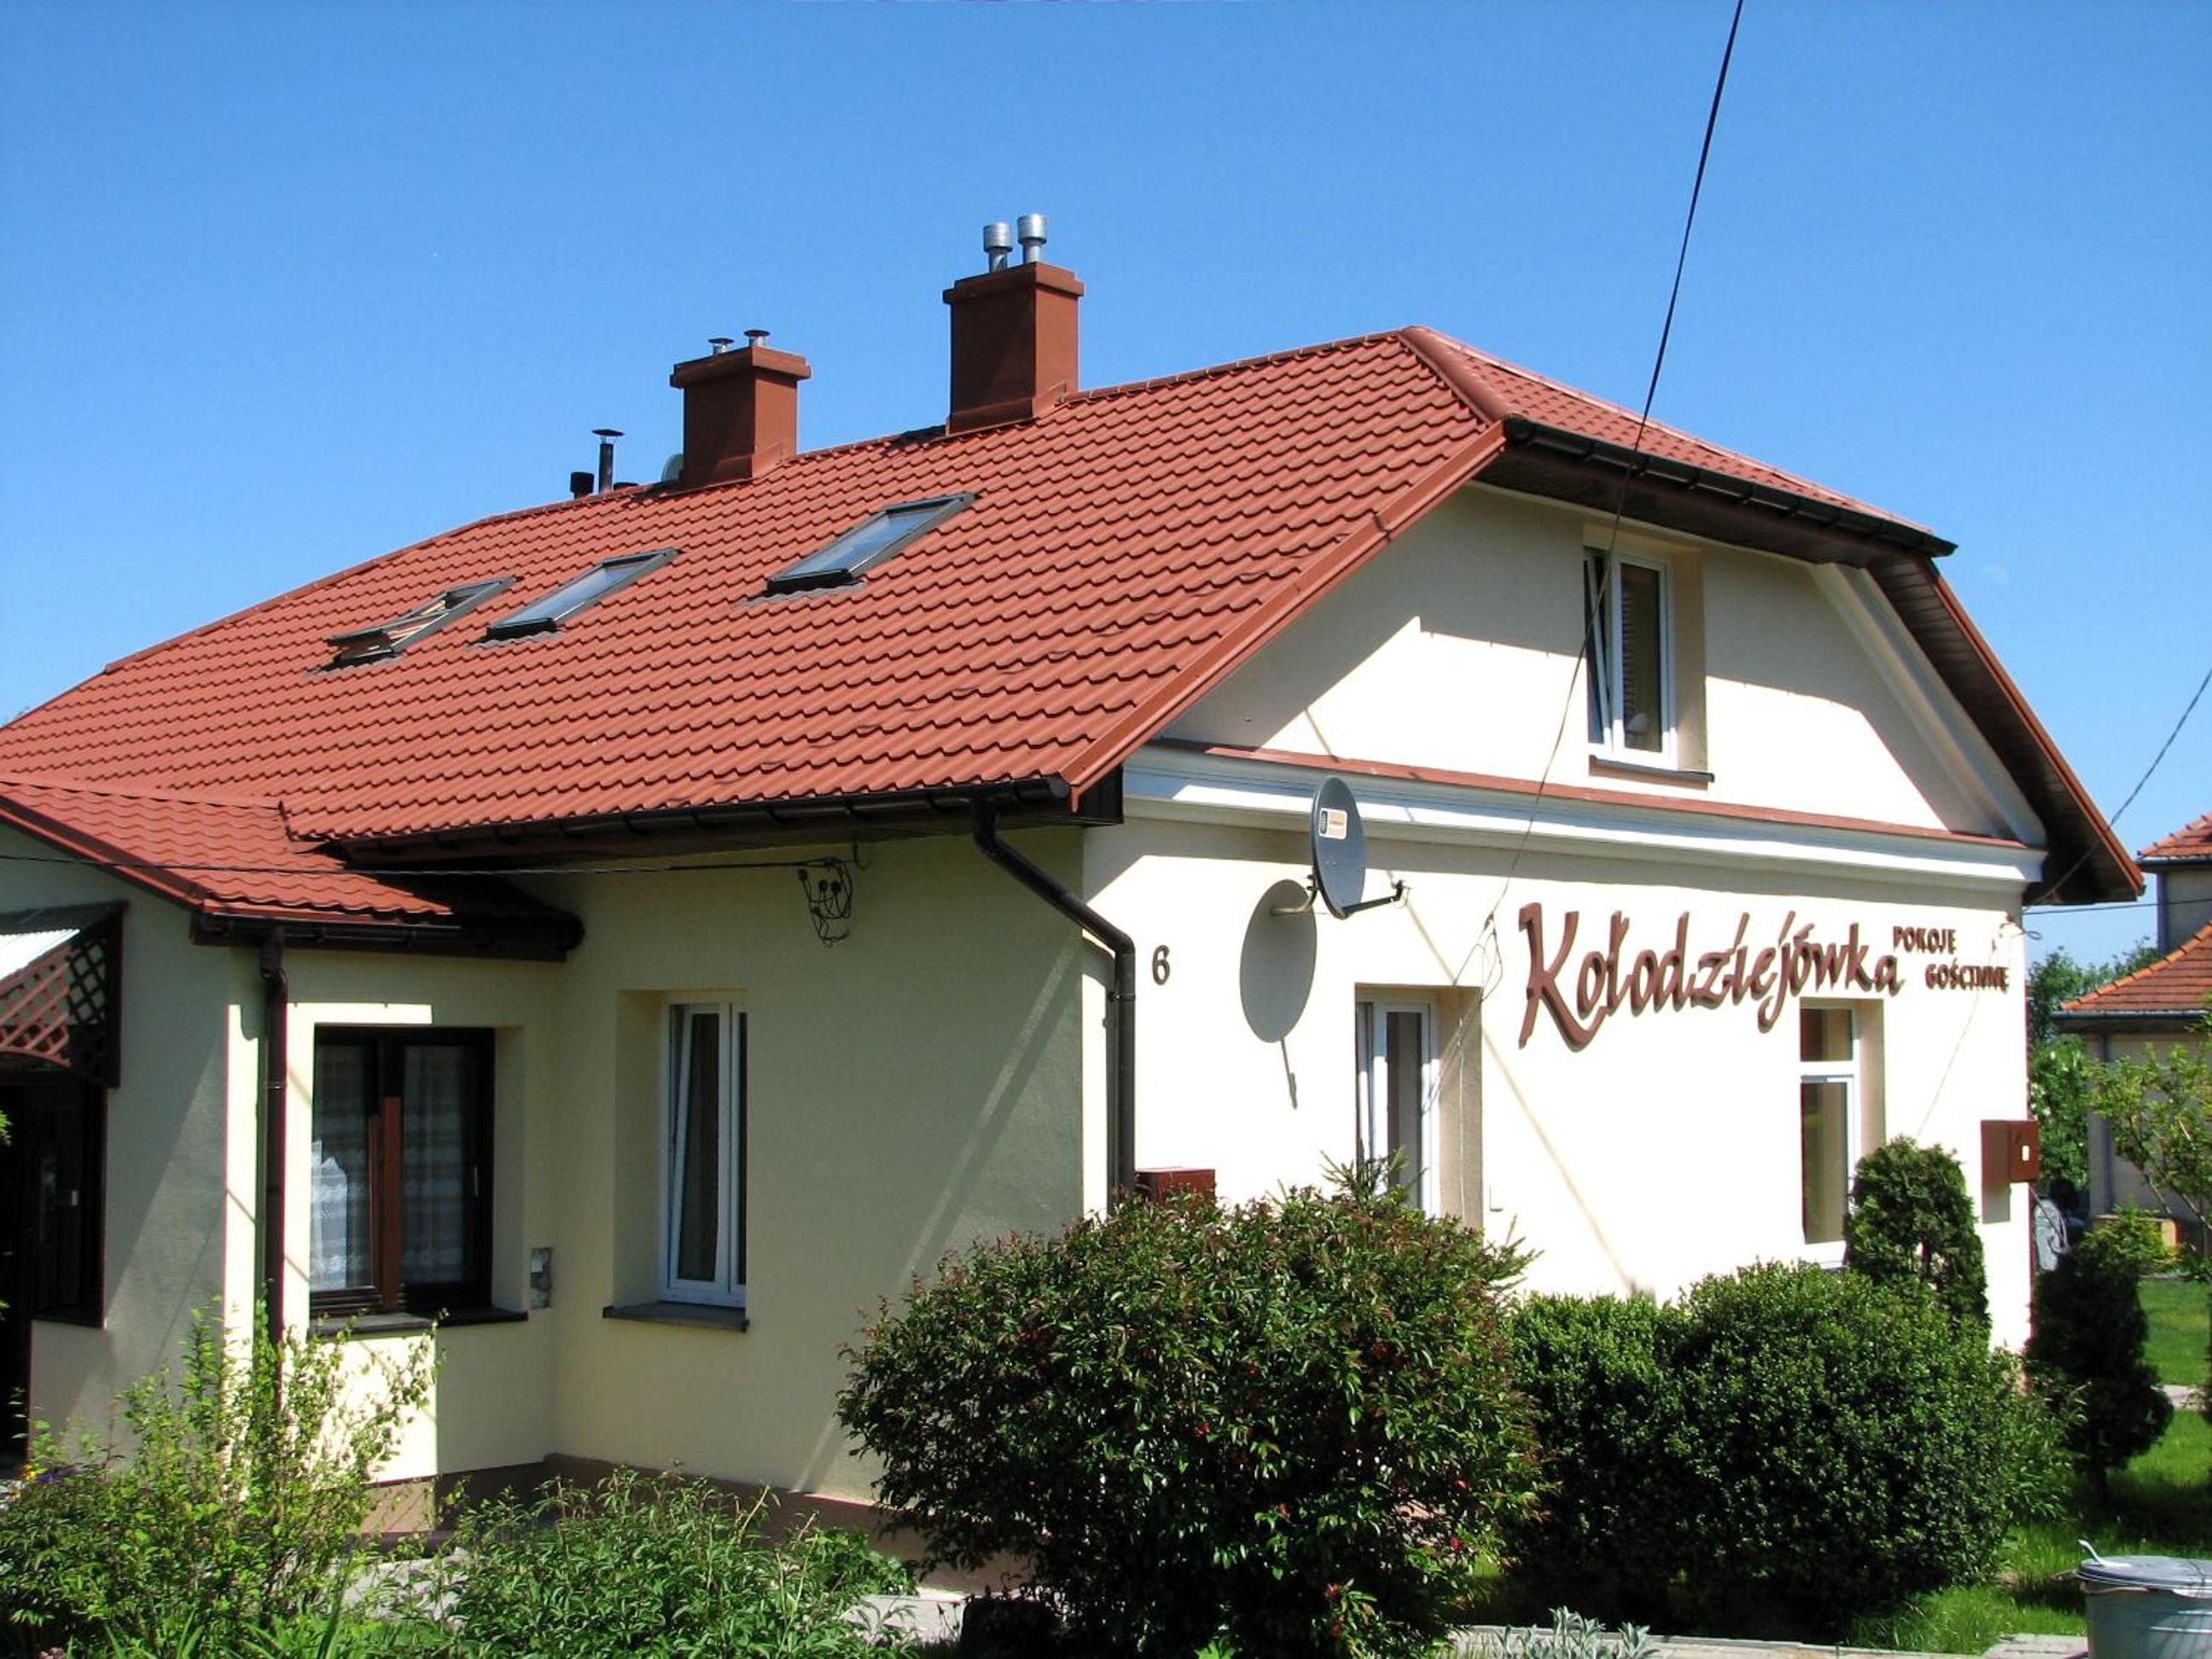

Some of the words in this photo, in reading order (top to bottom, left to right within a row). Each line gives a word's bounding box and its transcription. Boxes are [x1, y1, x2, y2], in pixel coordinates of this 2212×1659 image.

[1892, 925, 1957, 954] POKOJE
[1152, 945, 1170, 986] 6
[1518, 902, 1905, 1053] Kołodziejówka
[1924, 957, 2010, 993] GOŚCINNE
